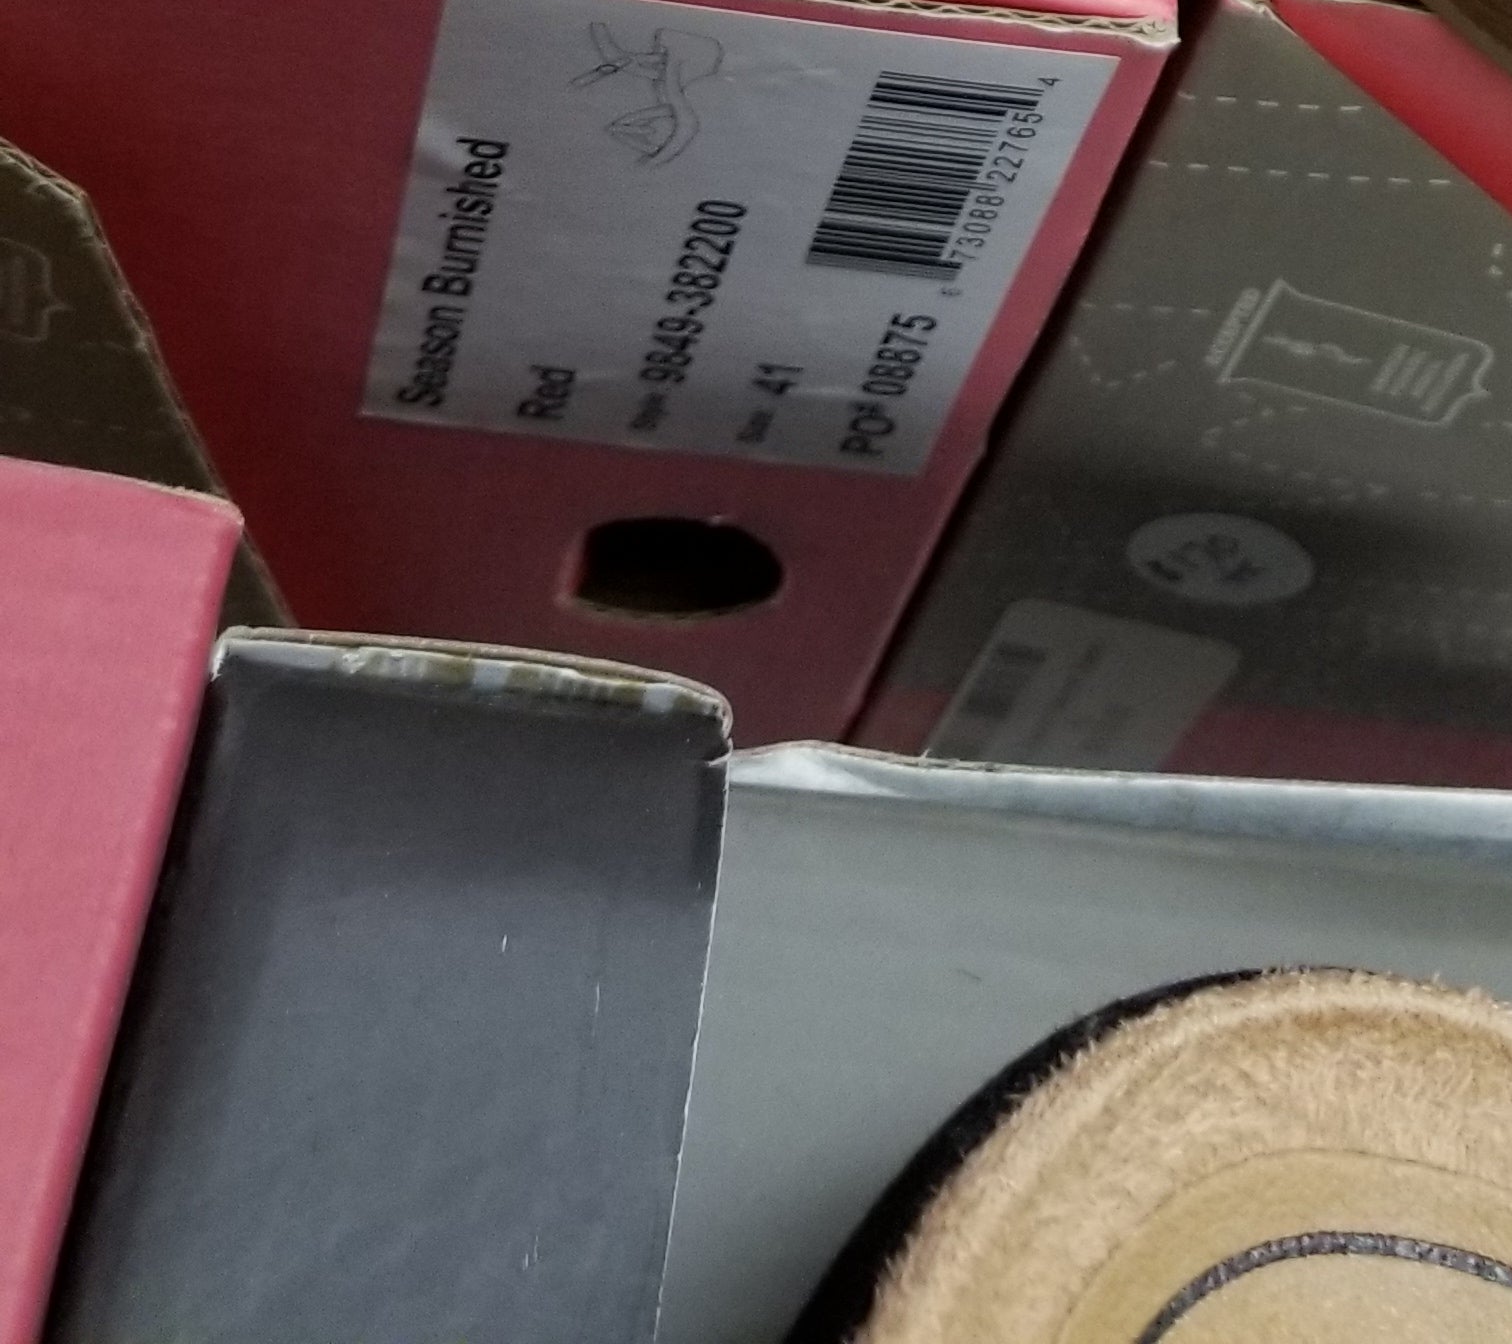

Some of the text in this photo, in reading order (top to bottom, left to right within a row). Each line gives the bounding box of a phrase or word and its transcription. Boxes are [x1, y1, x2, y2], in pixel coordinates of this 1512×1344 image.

[951, 194, 1006, 261] 73088
[986, 112, 1044, 184] 22765
[1037, 76, 1063, 88] 4
[396, 136, 511, 408] Season Burnished
[638, 199, 748, 384] 9849-382200
[516, 364, 577, 421] Red
[752, 363, 804, 396] 41
[861, 313, 938, 396] 08875
